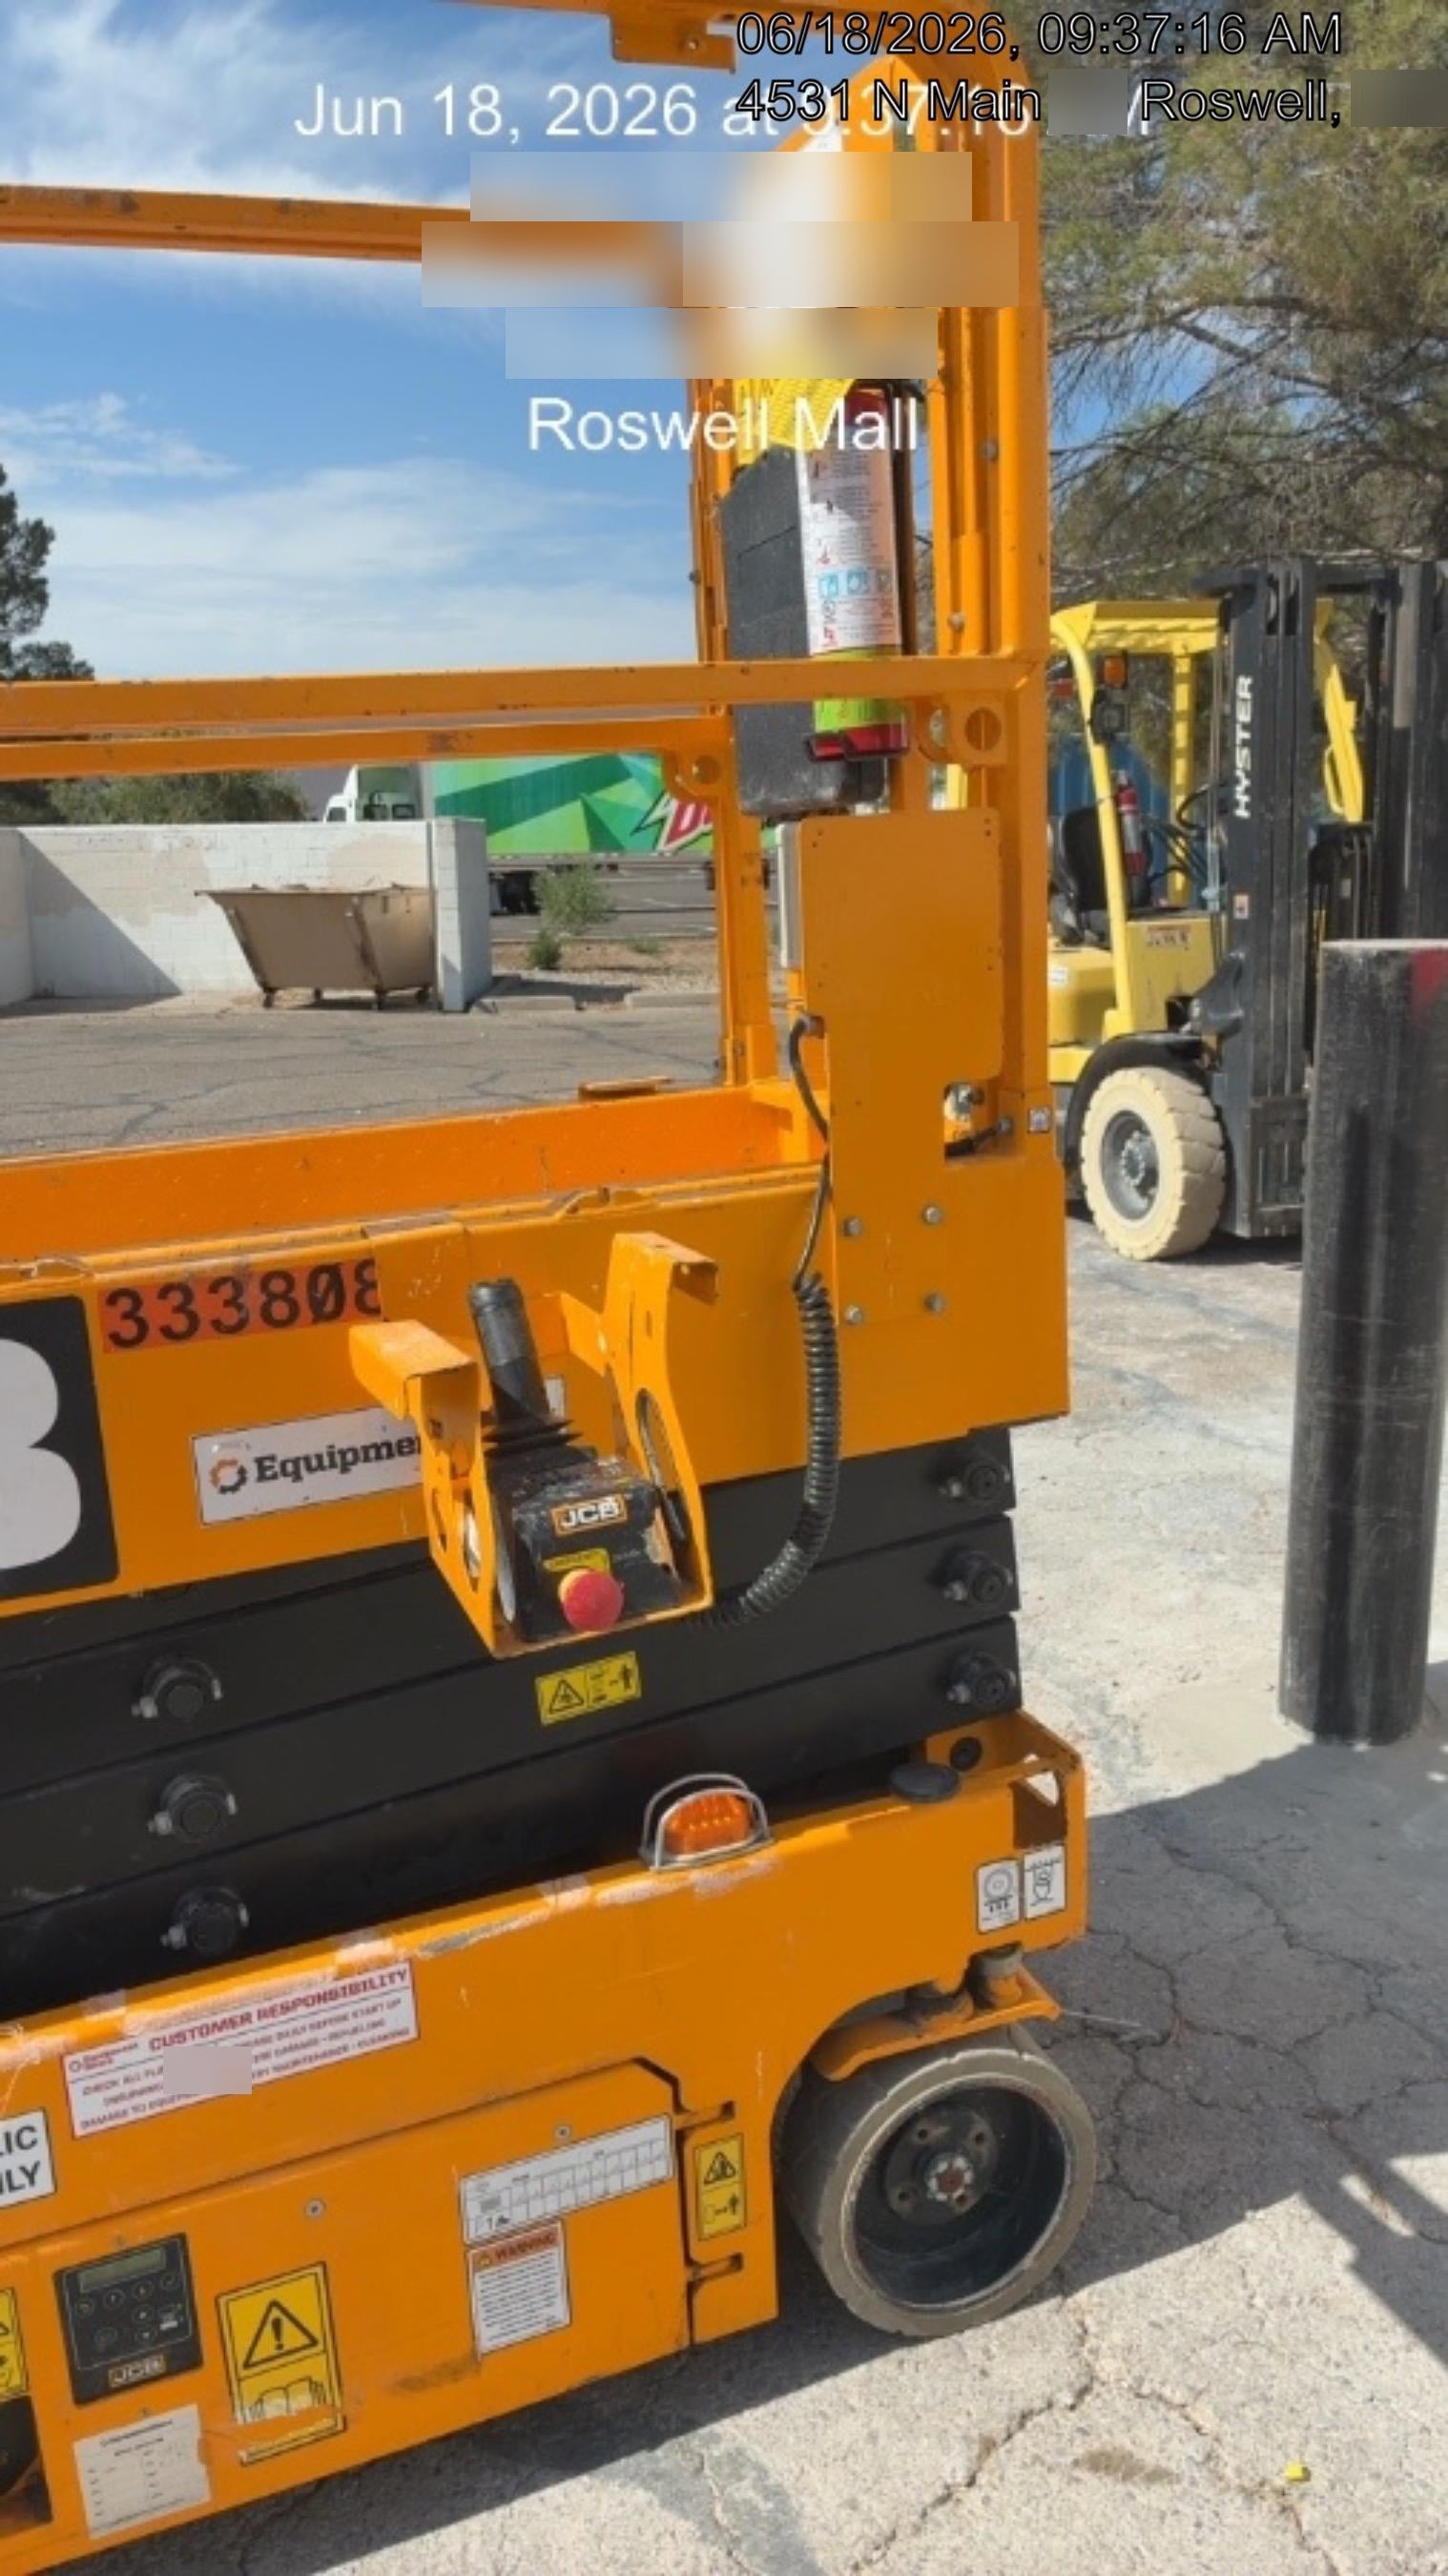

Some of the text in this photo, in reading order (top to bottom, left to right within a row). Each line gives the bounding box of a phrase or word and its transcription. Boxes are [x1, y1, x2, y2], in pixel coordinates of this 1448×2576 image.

[1234, 675, 1253, 819] HYSTER
[105, 1258, 382, 1349] 333808
[560, 1496, 619, 1527] JCB
[149, 1968, 407, 2051] CUSTOMER RESPONSIBILITY
